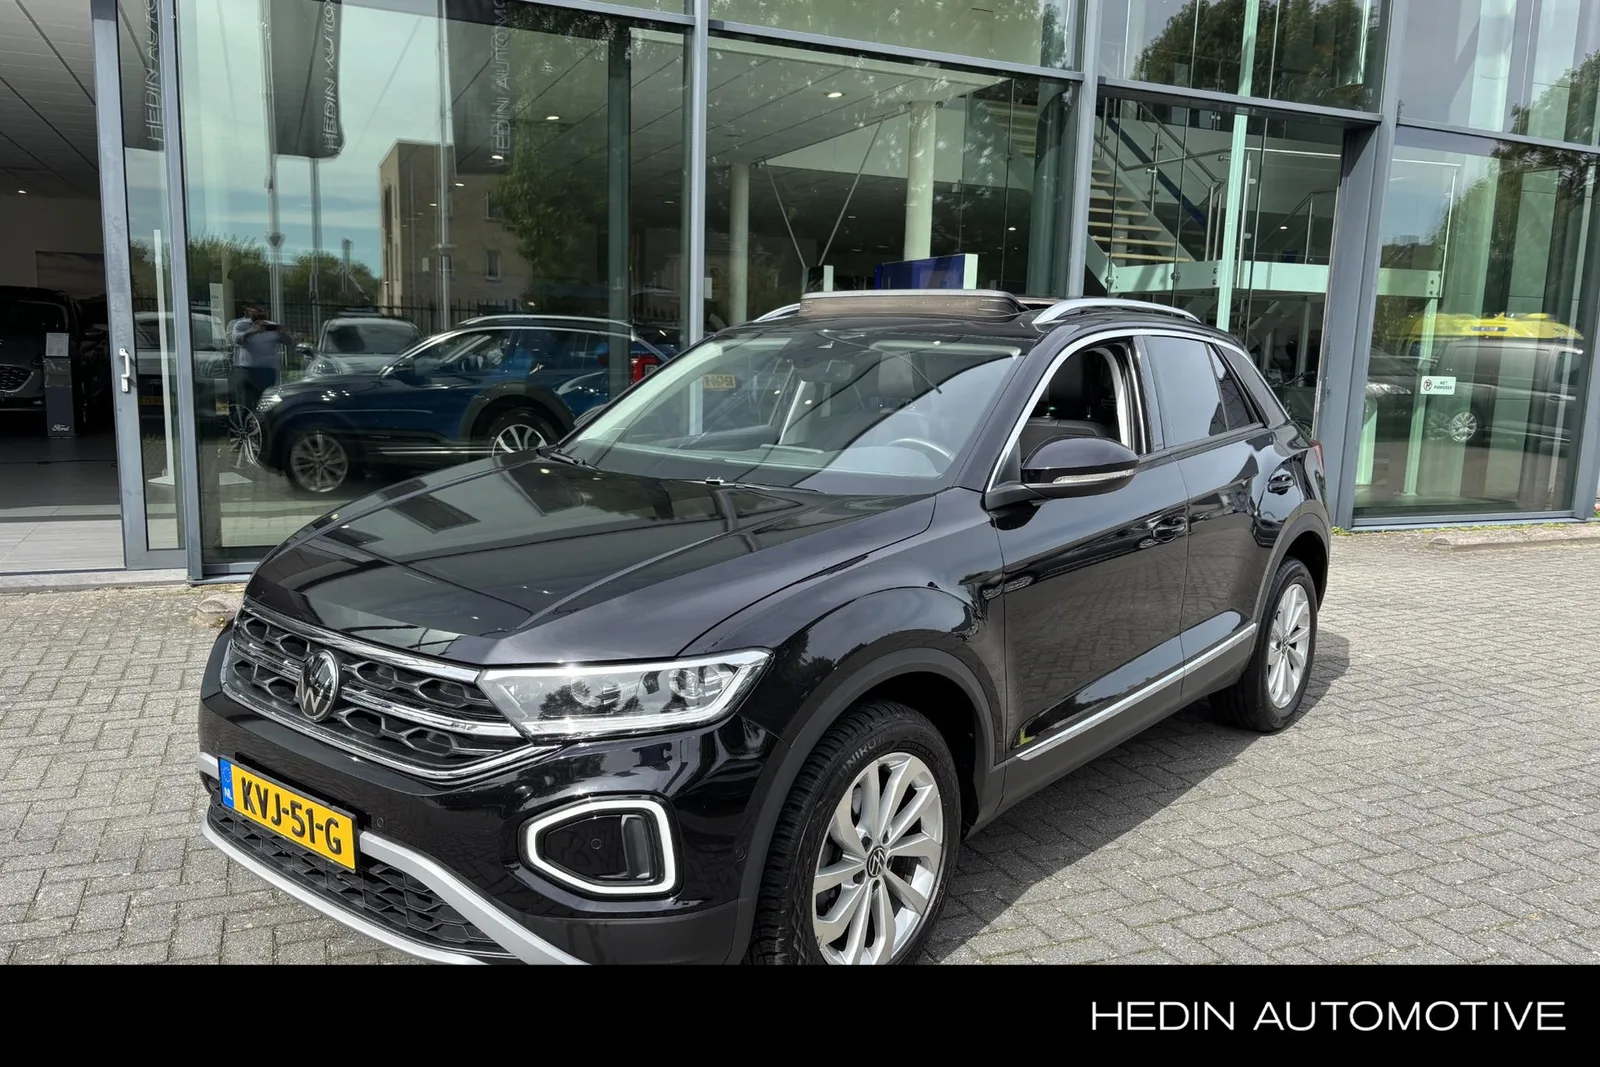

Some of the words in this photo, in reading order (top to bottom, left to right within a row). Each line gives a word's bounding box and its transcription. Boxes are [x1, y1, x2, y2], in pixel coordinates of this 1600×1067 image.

[52, 423, 70, 432] Ford
[223, 785, 234, 801] NL
[240, 775, 343, 856] KVJ-51-G
